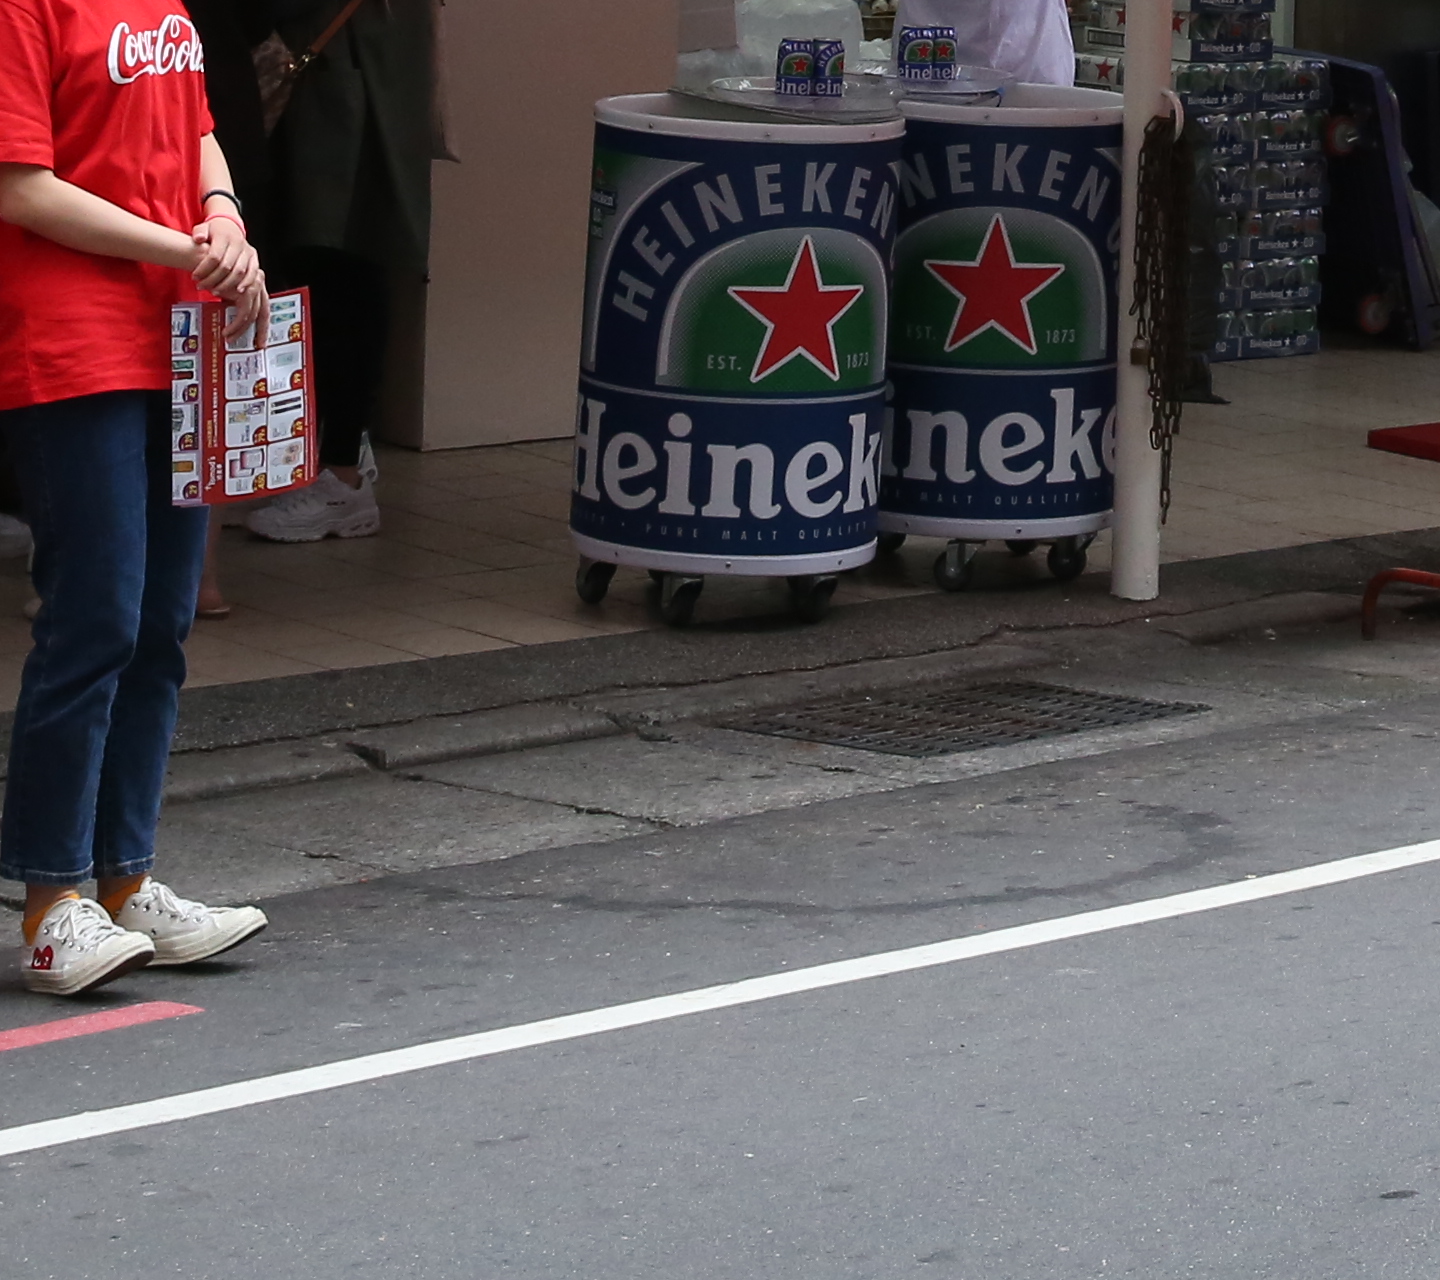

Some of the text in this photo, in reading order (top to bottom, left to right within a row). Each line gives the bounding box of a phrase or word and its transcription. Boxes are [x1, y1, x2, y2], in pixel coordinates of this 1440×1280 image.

[611, 161, 897, 323] HEINEKEN
[1045, 328, 1076, 344] 1873
[707, 352, 869, 371] EST. 1873
[722, 529, 779, 541] MALT
